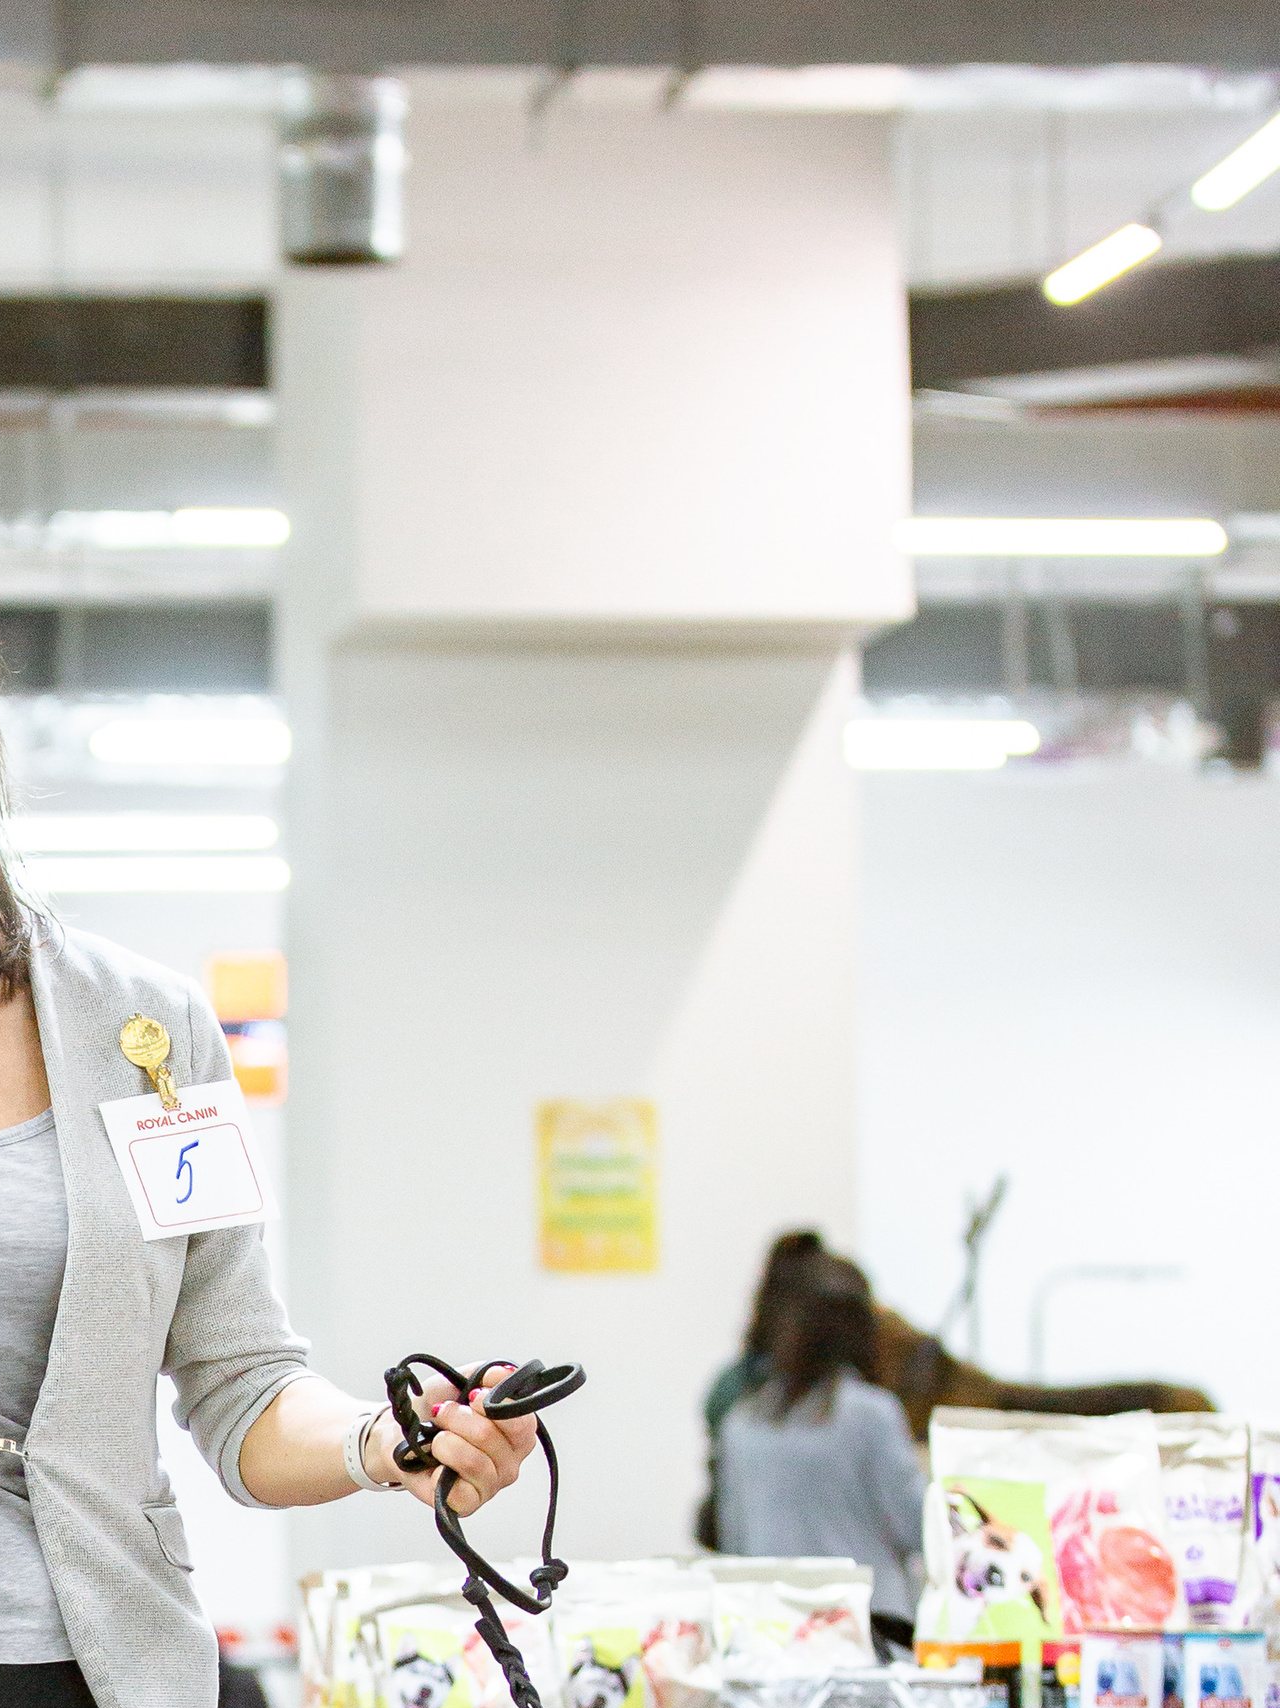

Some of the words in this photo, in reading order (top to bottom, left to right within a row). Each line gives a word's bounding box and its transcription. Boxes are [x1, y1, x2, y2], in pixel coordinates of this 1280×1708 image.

[136, 1114, 176, 1131] ROYAL
[177, 1106, 219, 1123] CANIN
[176, 1139, 199, 1204] 5
